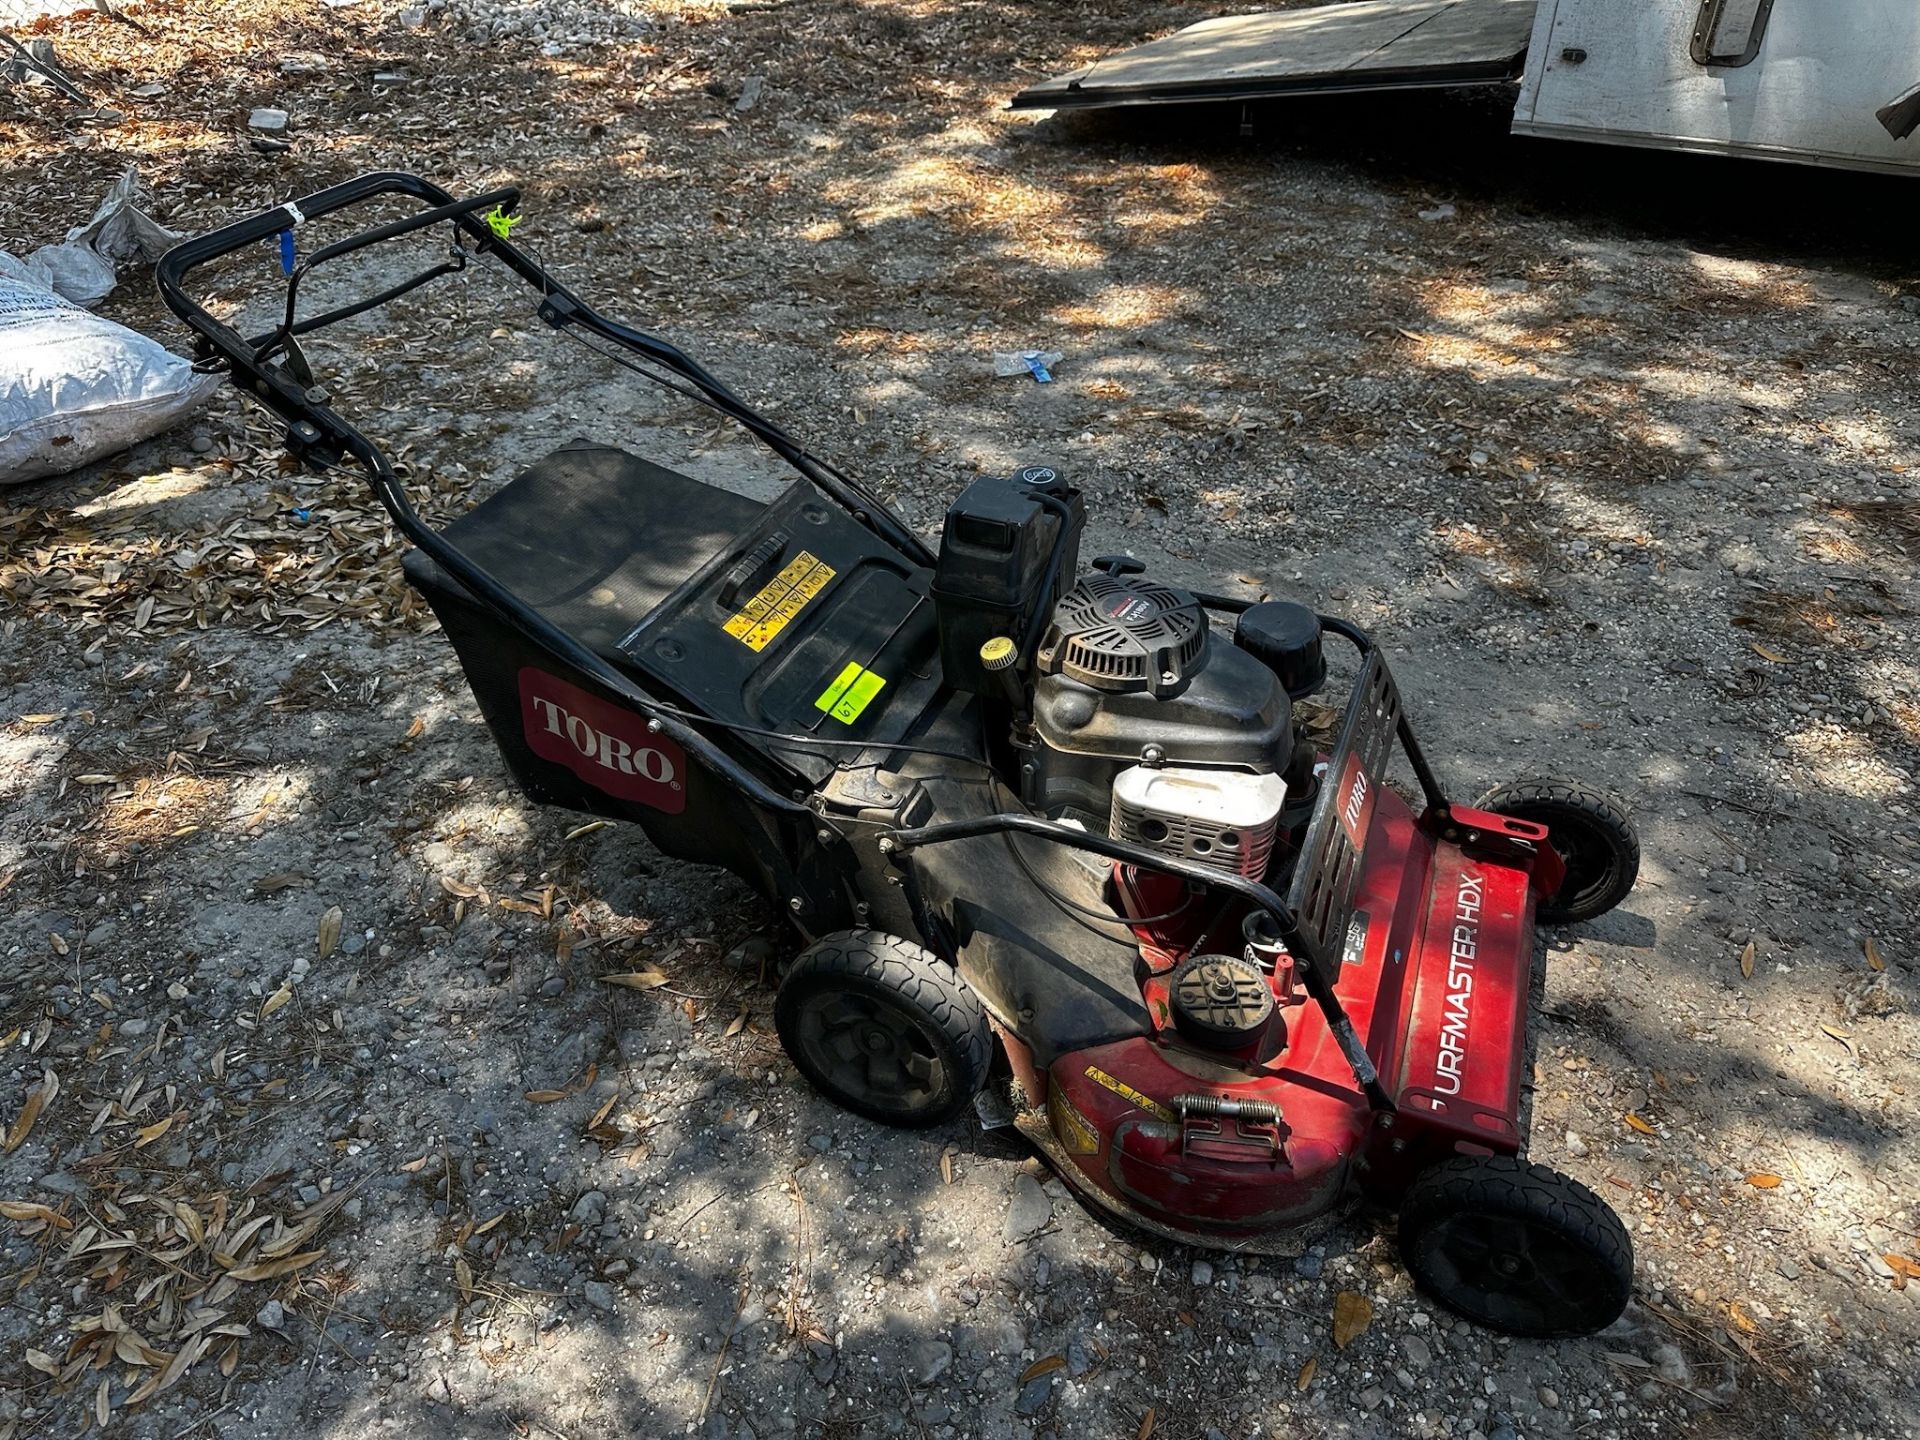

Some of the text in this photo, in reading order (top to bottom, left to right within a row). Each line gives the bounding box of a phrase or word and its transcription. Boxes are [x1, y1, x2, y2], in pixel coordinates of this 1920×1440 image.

[837, 700, 857, 717] 67
[533, 696, 675, 783] TORO
[1345, 771, 1367, 831] TORO
[1456, 873, 1483, 923] HDX
